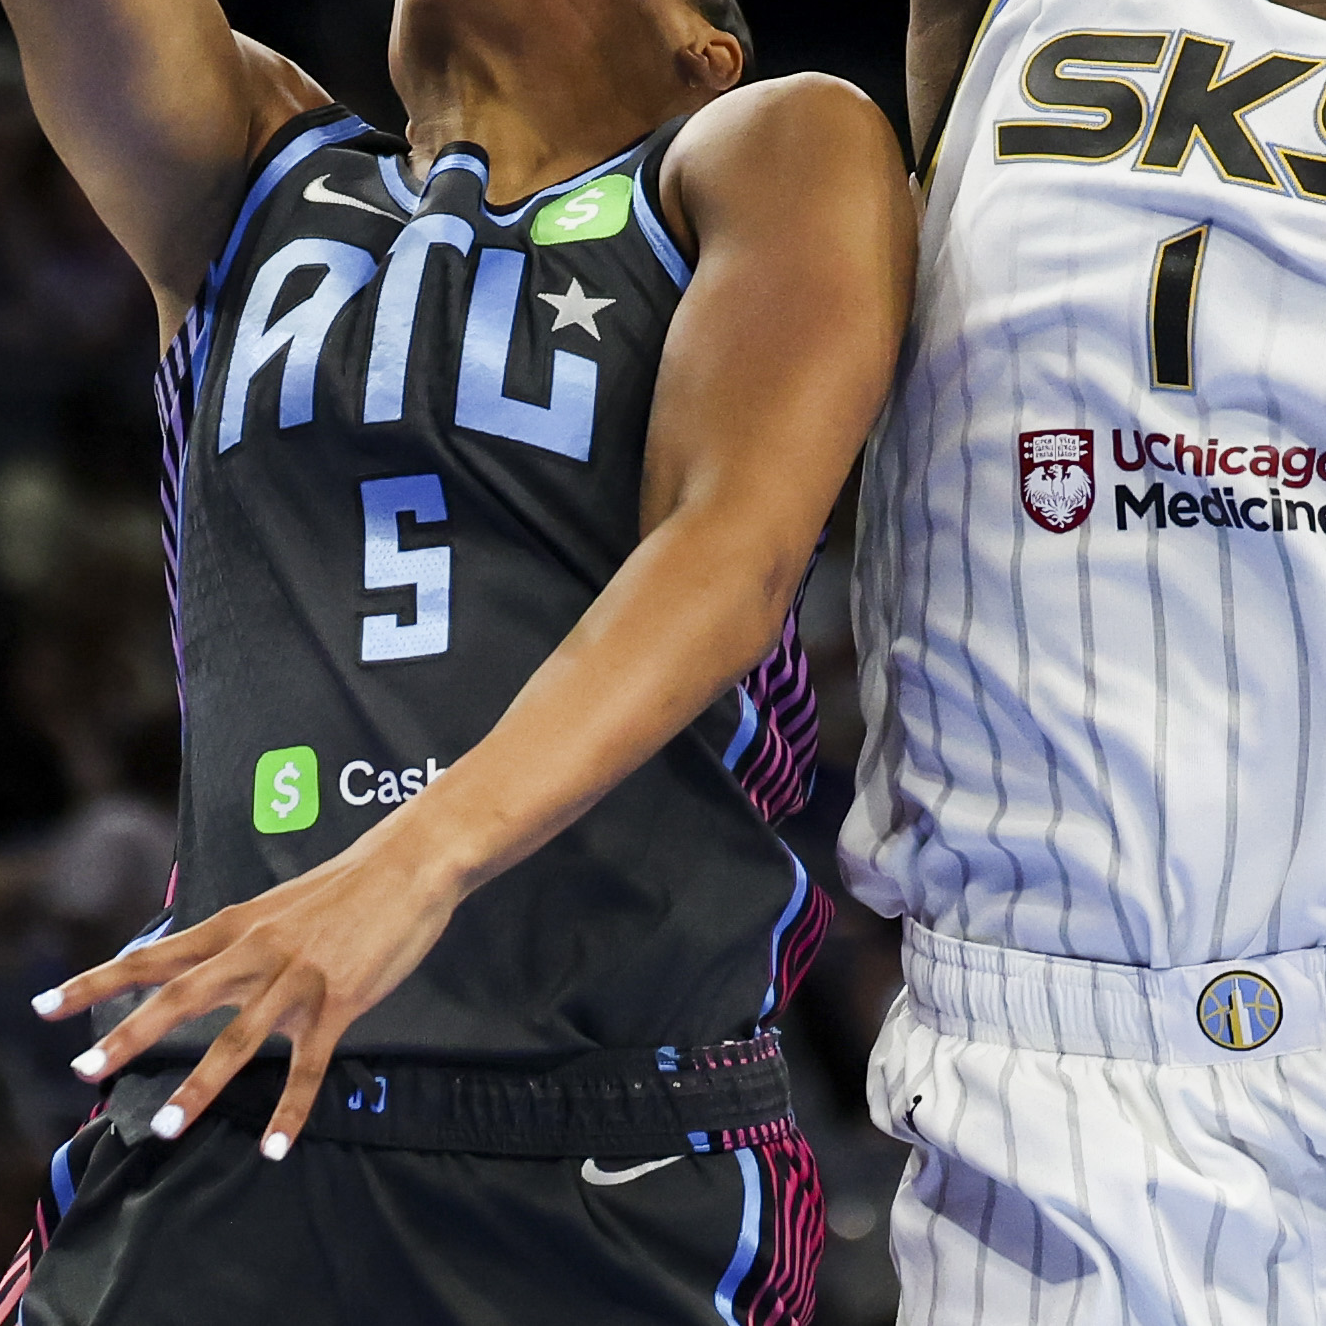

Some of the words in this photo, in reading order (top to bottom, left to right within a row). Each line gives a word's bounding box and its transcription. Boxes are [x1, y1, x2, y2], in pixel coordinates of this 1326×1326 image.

[217, 212, 598, 463] ATL
[1145, 220, 1212, 396] 1
[360, 473, 451, 663] 5
